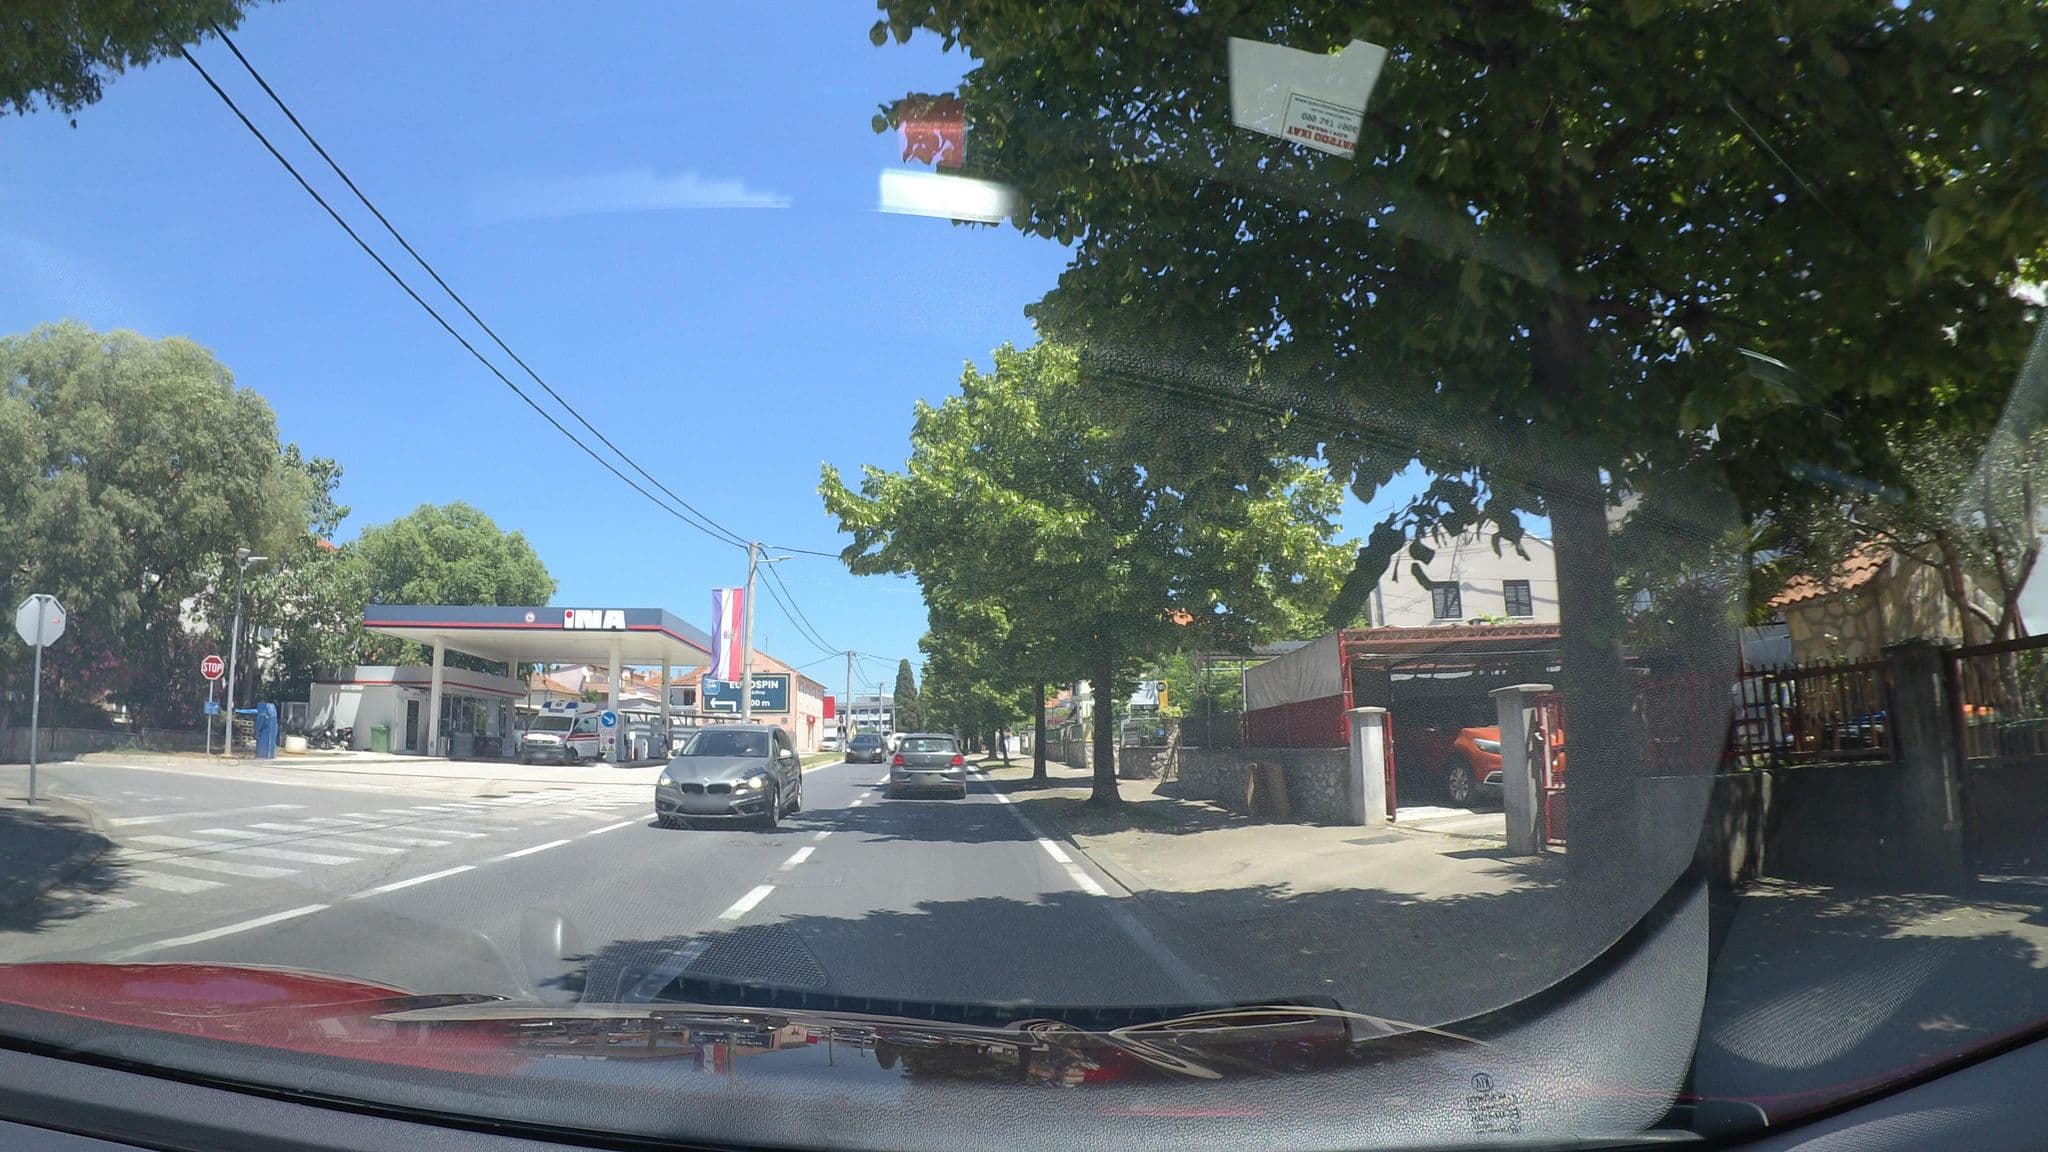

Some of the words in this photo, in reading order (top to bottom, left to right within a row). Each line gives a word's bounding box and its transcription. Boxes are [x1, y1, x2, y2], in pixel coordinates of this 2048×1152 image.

[564, 609, 626, 629] INA
[204, 662, 222, 673] STOP
[729, 680, 779, 689] EUOSPIN
